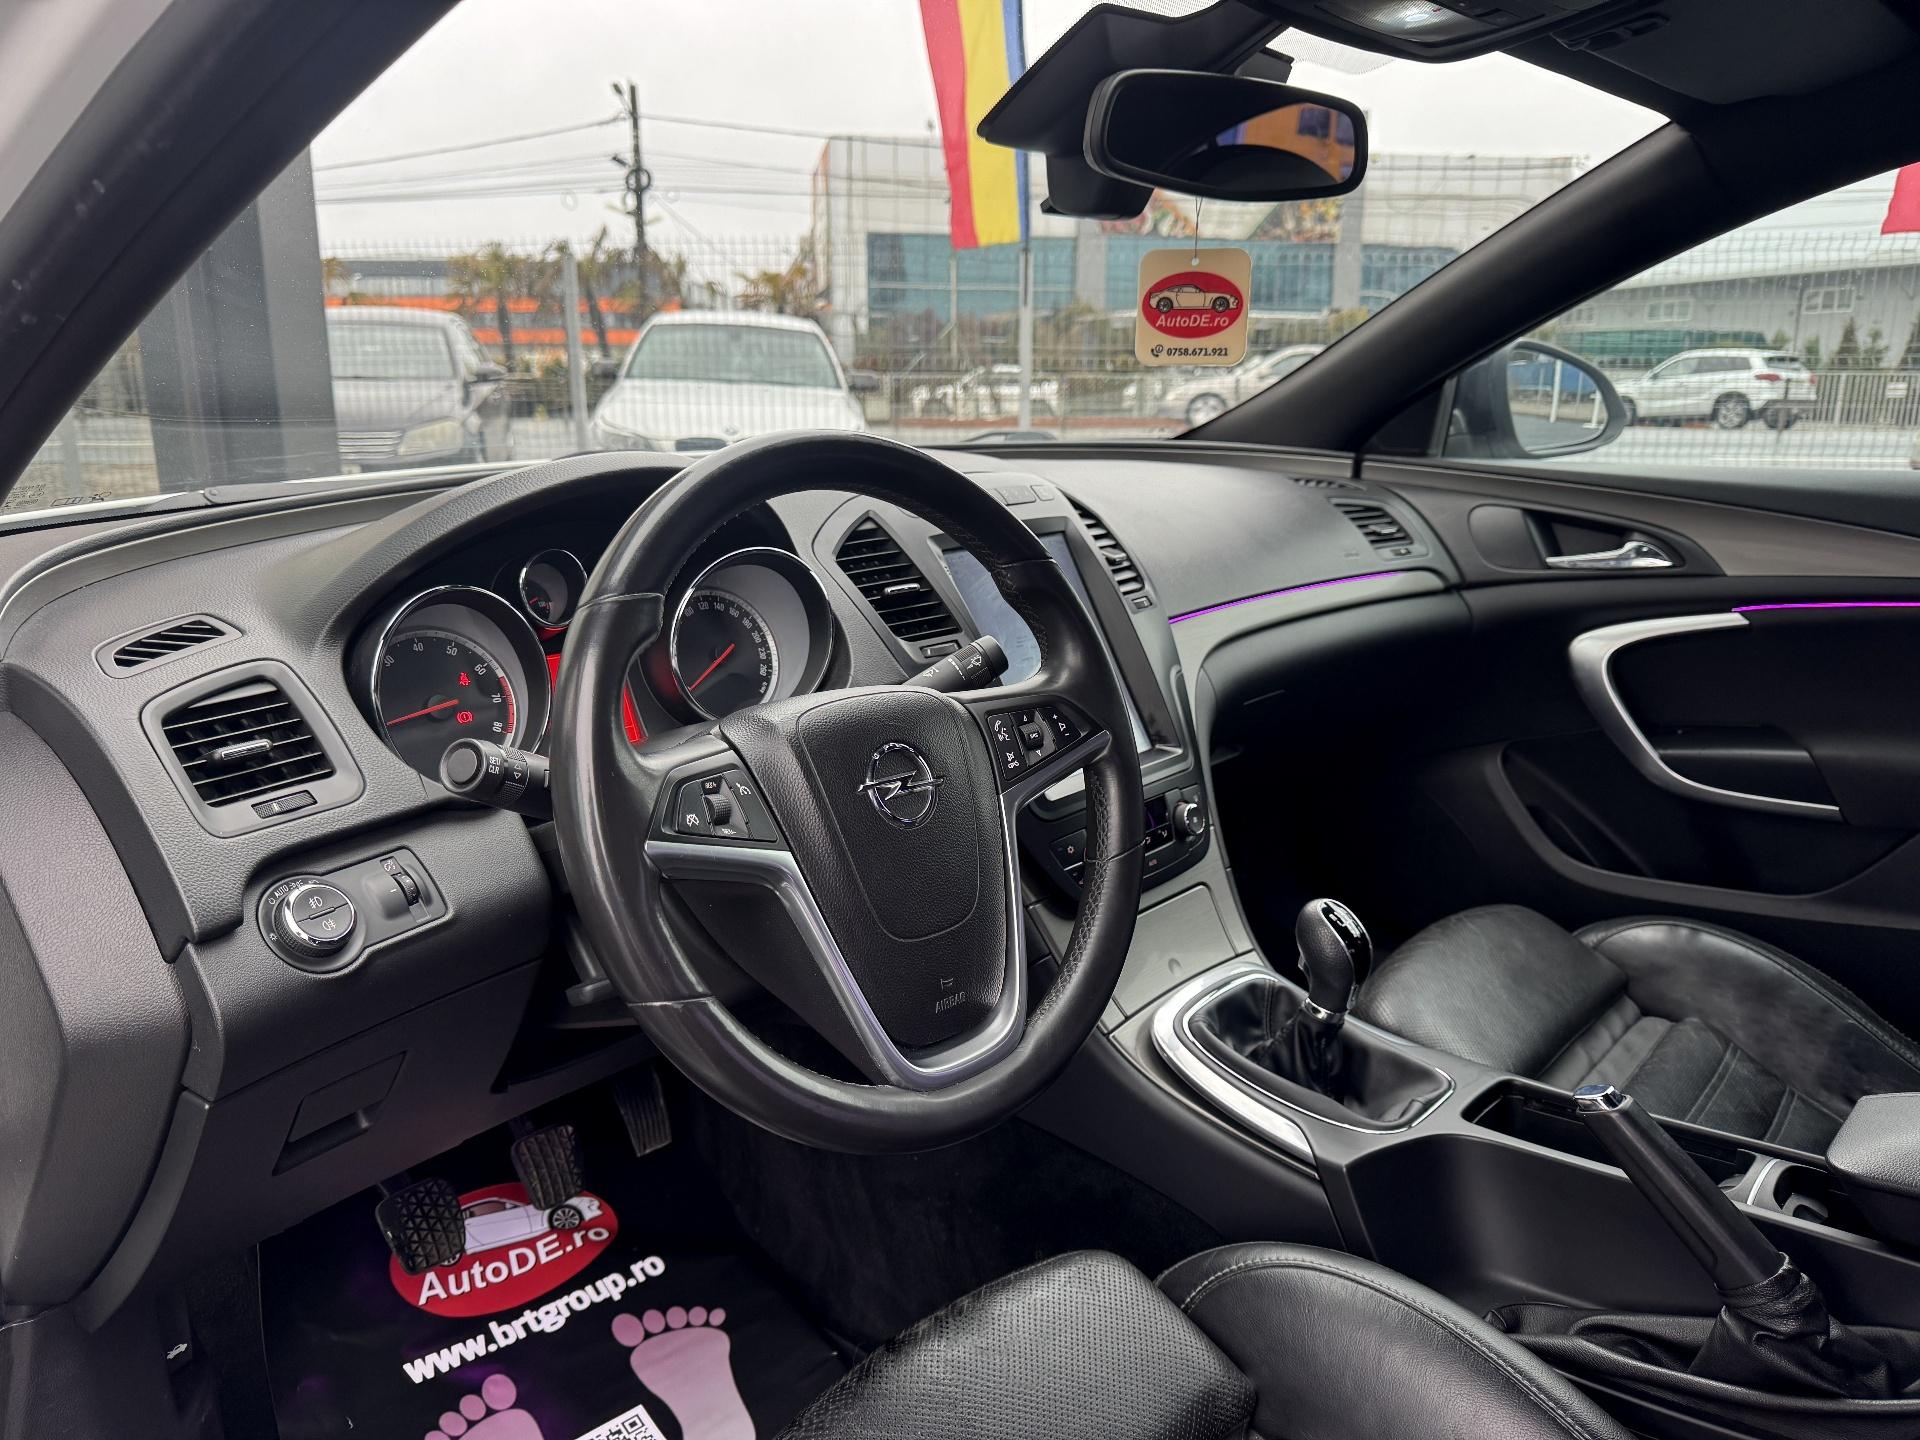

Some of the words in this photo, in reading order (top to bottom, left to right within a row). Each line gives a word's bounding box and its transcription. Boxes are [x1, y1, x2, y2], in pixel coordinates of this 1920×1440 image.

[1155, 314, 1230, 328] AutoDE.ro
[1166, 347, 1229, 357] 0758.671.921
[698, 601, 710, 610] 120
[713, 602, 725, 612] 140
[729, 606, 740, 618] 160
[742, 617, 753, 629] 180
[751, 630, 762, 644] 200
[413, 642, 424, 652] 40
[446, 645, 458, 656] 50
[474, 663, 487, 676] 60
[491, 692, 502, 704] 70
[492, 721, 503, 733] 80
[488, 765, 500, 775] CLR
[274, 884, 289, 898] AUTO
[418, 1226, 610, 1306] AutoDE.ro
[402, 1255, 666, 1384] www.brtgroup.ro
